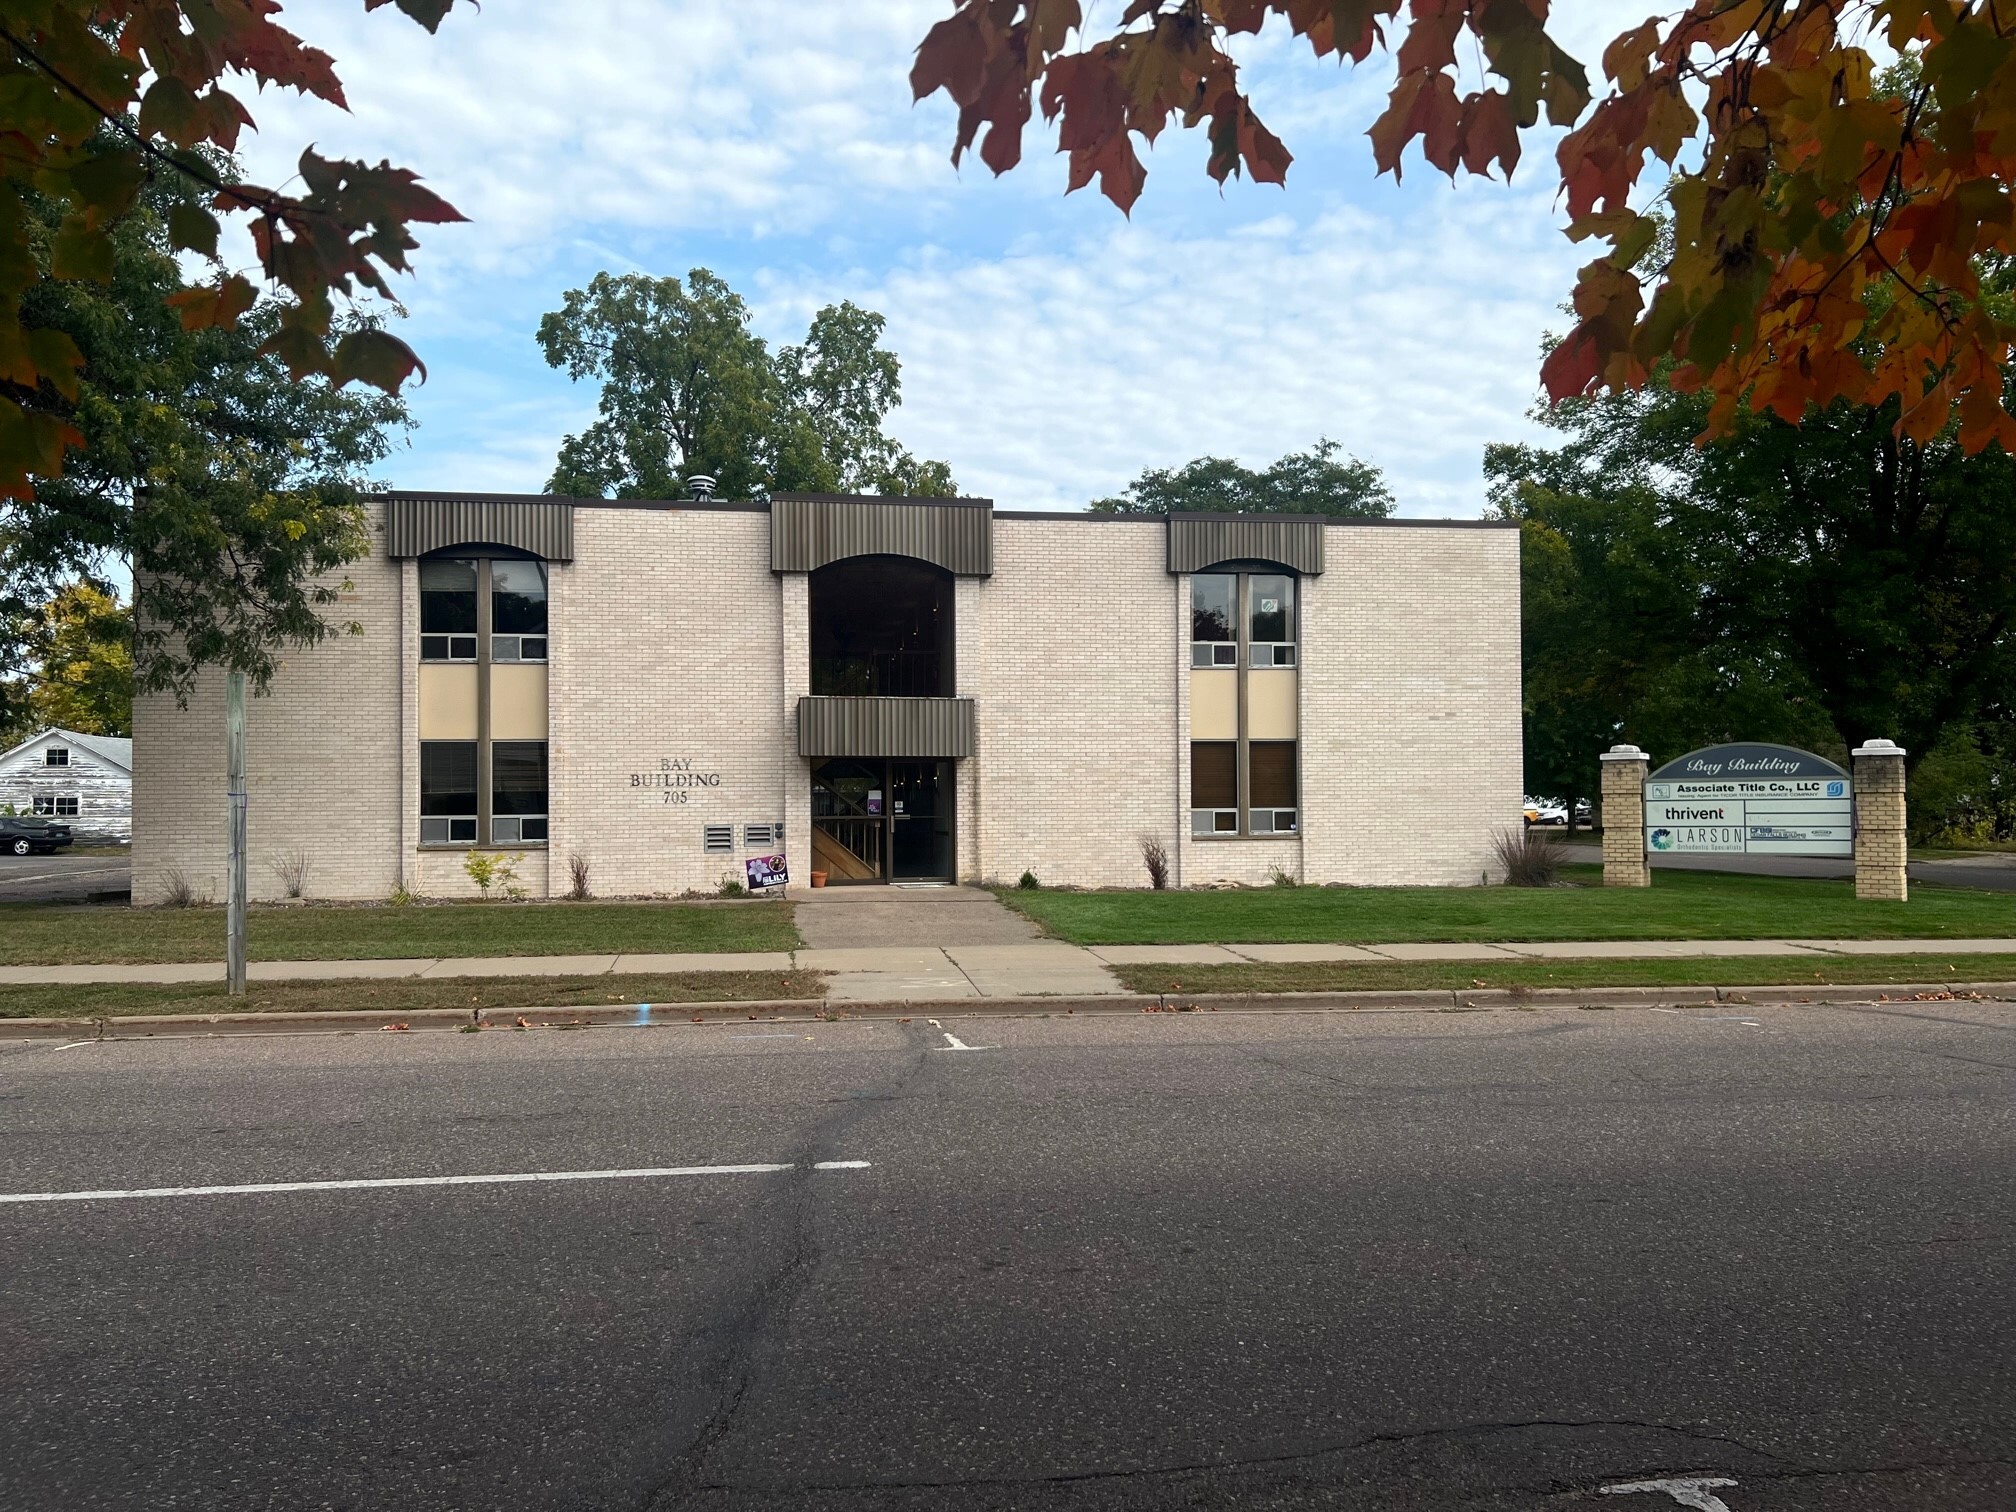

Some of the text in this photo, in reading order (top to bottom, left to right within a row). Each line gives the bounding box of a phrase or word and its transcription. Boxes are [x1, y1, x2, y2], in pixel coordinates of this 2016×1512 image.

[661, 758, 692, 771] BAY
[1687, 758, 1800, 775] Bay Building
[630, 774, 720, 787] BUILDING
[1677, 782, 1820, 793] Associate Title Co., LLC
[664, 791, 687, 804] 705
[1665, 807, 1724, 820] thrivent
[1677, 829, 1742, 843] LARSON
[769, 873, 786, 882] LILY
